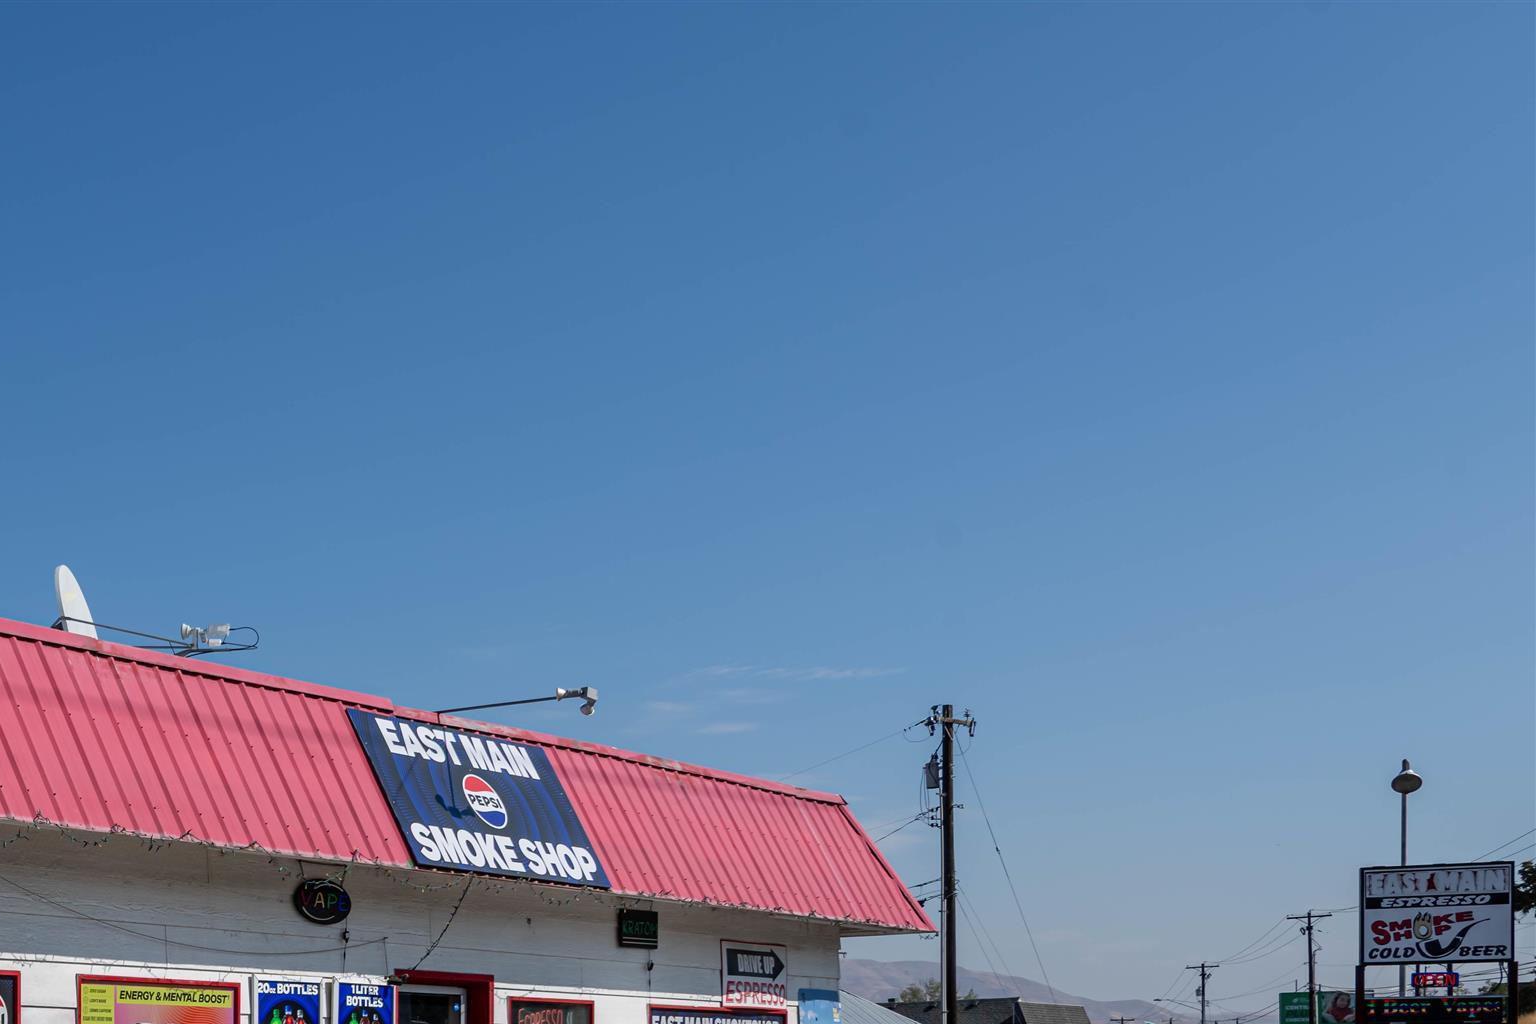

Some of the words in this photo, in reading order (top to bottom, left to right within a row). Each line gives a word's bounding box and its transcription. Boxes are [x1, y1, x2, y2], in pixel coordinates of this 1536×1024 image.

[375, 717, 462, 766] EAST
[458, 734, 541, 780] MAIN
[468, 791, 503, 810] PEPSI
[410, 822, 527, 873] SMOKE
[518, 838, 597, 881] SHOP
[1367, 872, 1433, 896] EAST
[1436, 869, 1507, 892] MAIN
[300, 889, 349, 912] VAPE
[1380, 895, 1491, 908] ESPRESSO
[1369, 947, 1416, 959] COLD
[1459, 945, 1507, 957] BEER
[737, 953, 763, 973] DRIVE
[763, 955, 775, 974] UP
[119, 990, 154, 1000] ENERGY
[156, 992, 161, 1000] &
[163, 992, 197, 1002] MENTAL
[258, 983, 276, 994] 20oz
[277, 984, 318, 995] BOTTLES
[726, 980, 785, 1005] ESPRESSO
[346, 996, 384, 1008] BOTTLES
